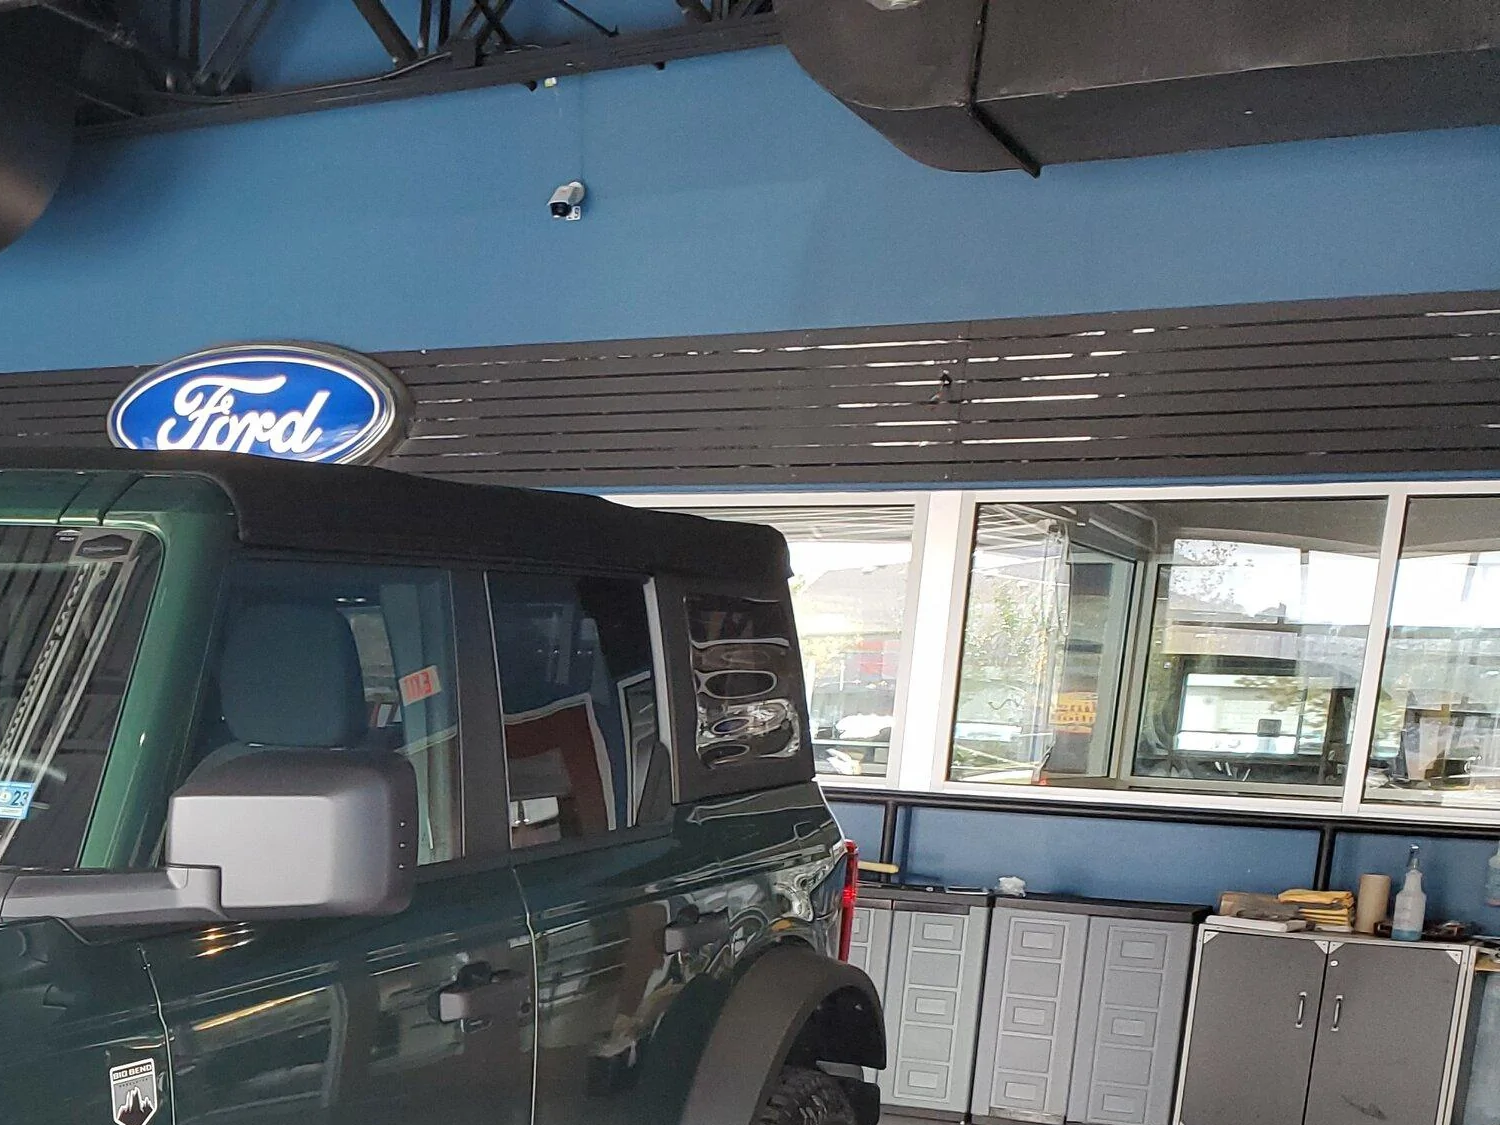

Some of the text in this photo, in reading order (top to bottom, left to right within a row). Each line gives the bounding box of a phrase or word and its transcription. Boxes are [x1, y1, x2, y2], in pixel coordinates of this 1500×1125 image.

[156, 374, 331, 453] Ford
[10, 790, 29, 807] 23
[113, 1064, 152, 1080] BIG BEND
